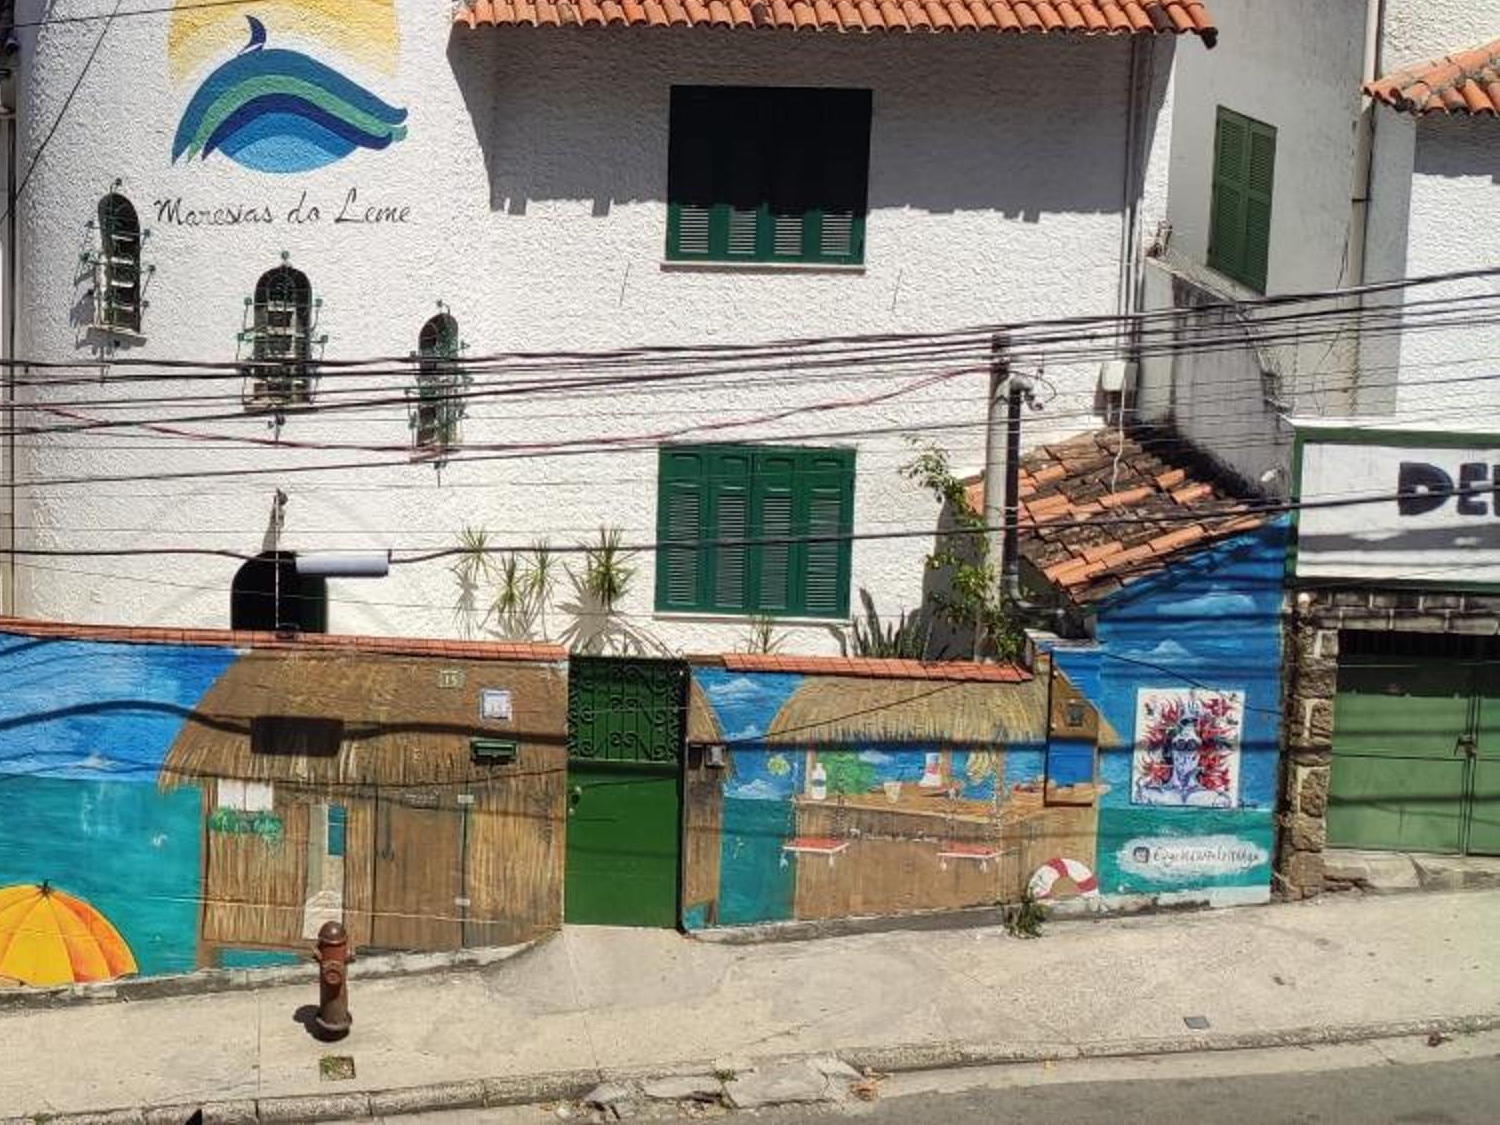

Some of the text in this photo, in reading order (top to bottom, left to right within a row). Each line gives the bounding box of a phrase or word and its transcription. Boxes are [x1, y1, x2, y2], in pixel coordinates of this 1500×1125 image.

[154, 187, 412, 226] Maresias do Leme
[1398, 462, 1500, 518] DE
